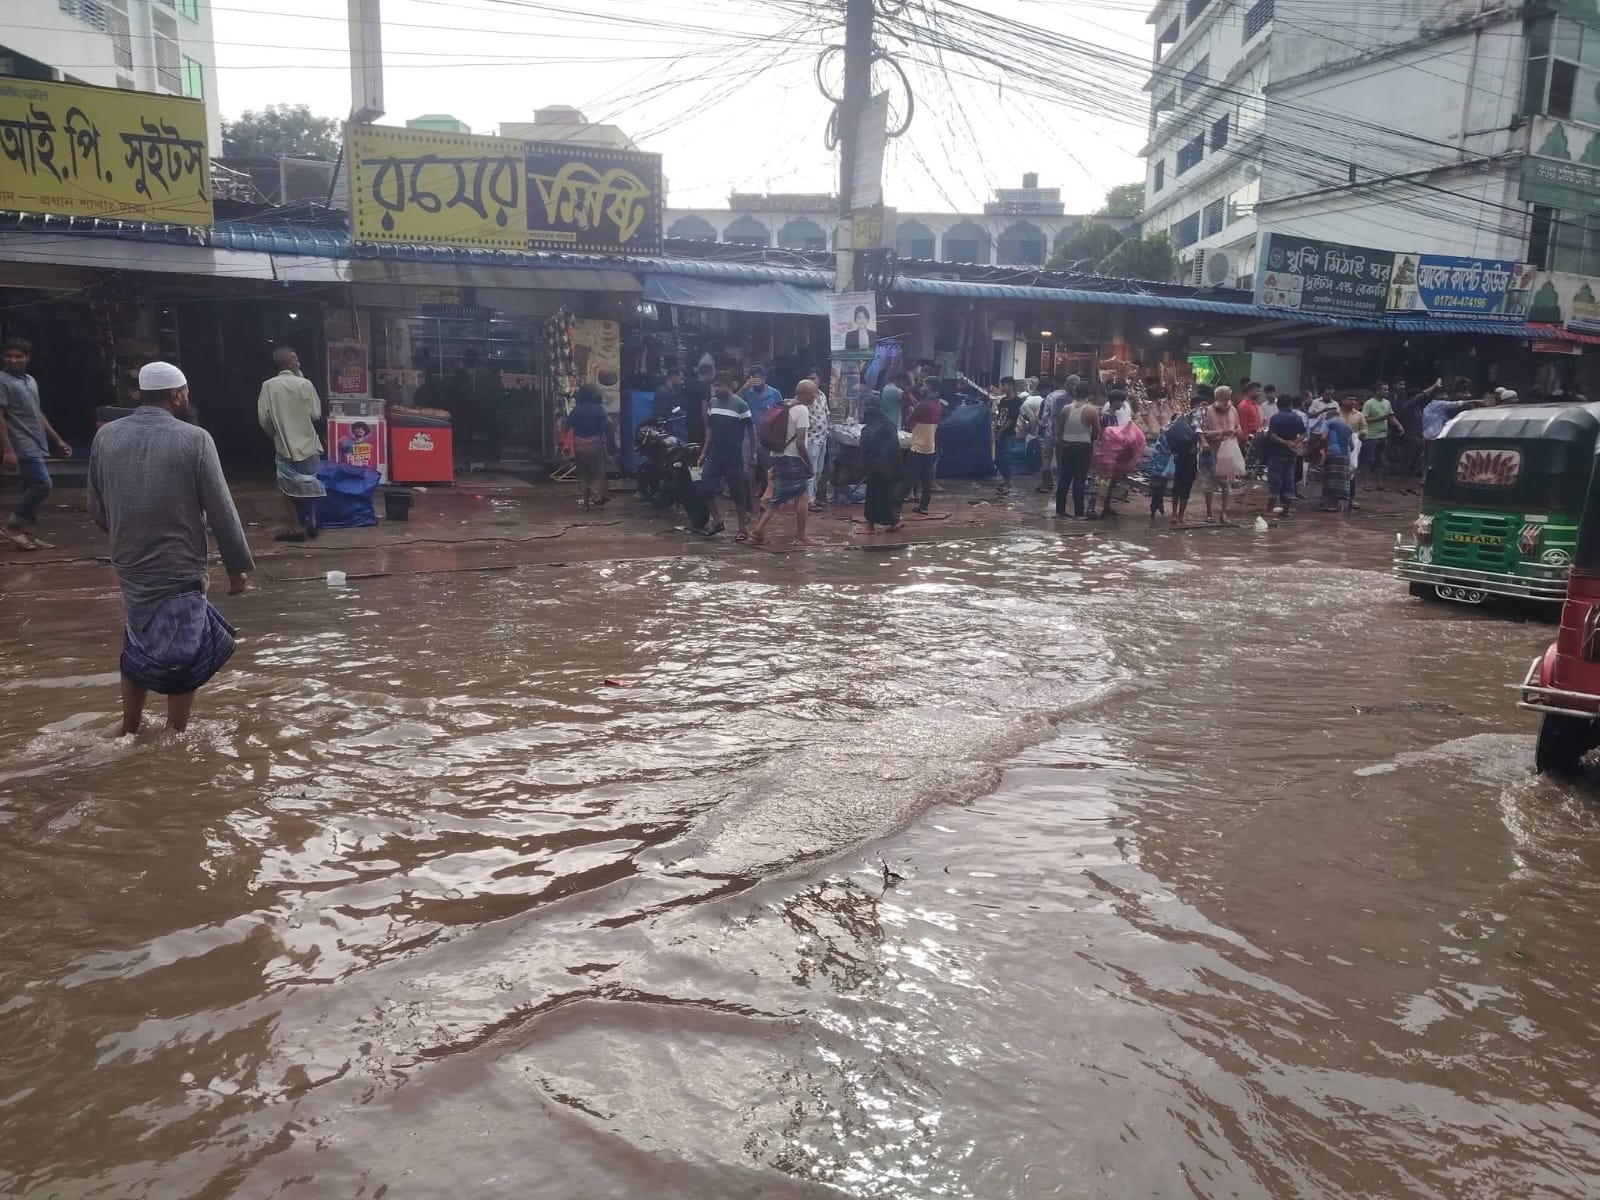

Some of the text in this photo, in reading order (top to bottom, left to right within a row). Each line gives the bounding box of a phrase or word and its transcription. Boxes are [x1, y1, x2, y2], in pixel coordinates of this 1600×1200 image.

[119, 115, 208, 203] সুইটস্
[1286, 246, 1392, 282] খুশি মিঠাই ঘর
[1482, 263, 1510, 295] হাউজ
[1355, 282, 1386, 298] বেকারি
